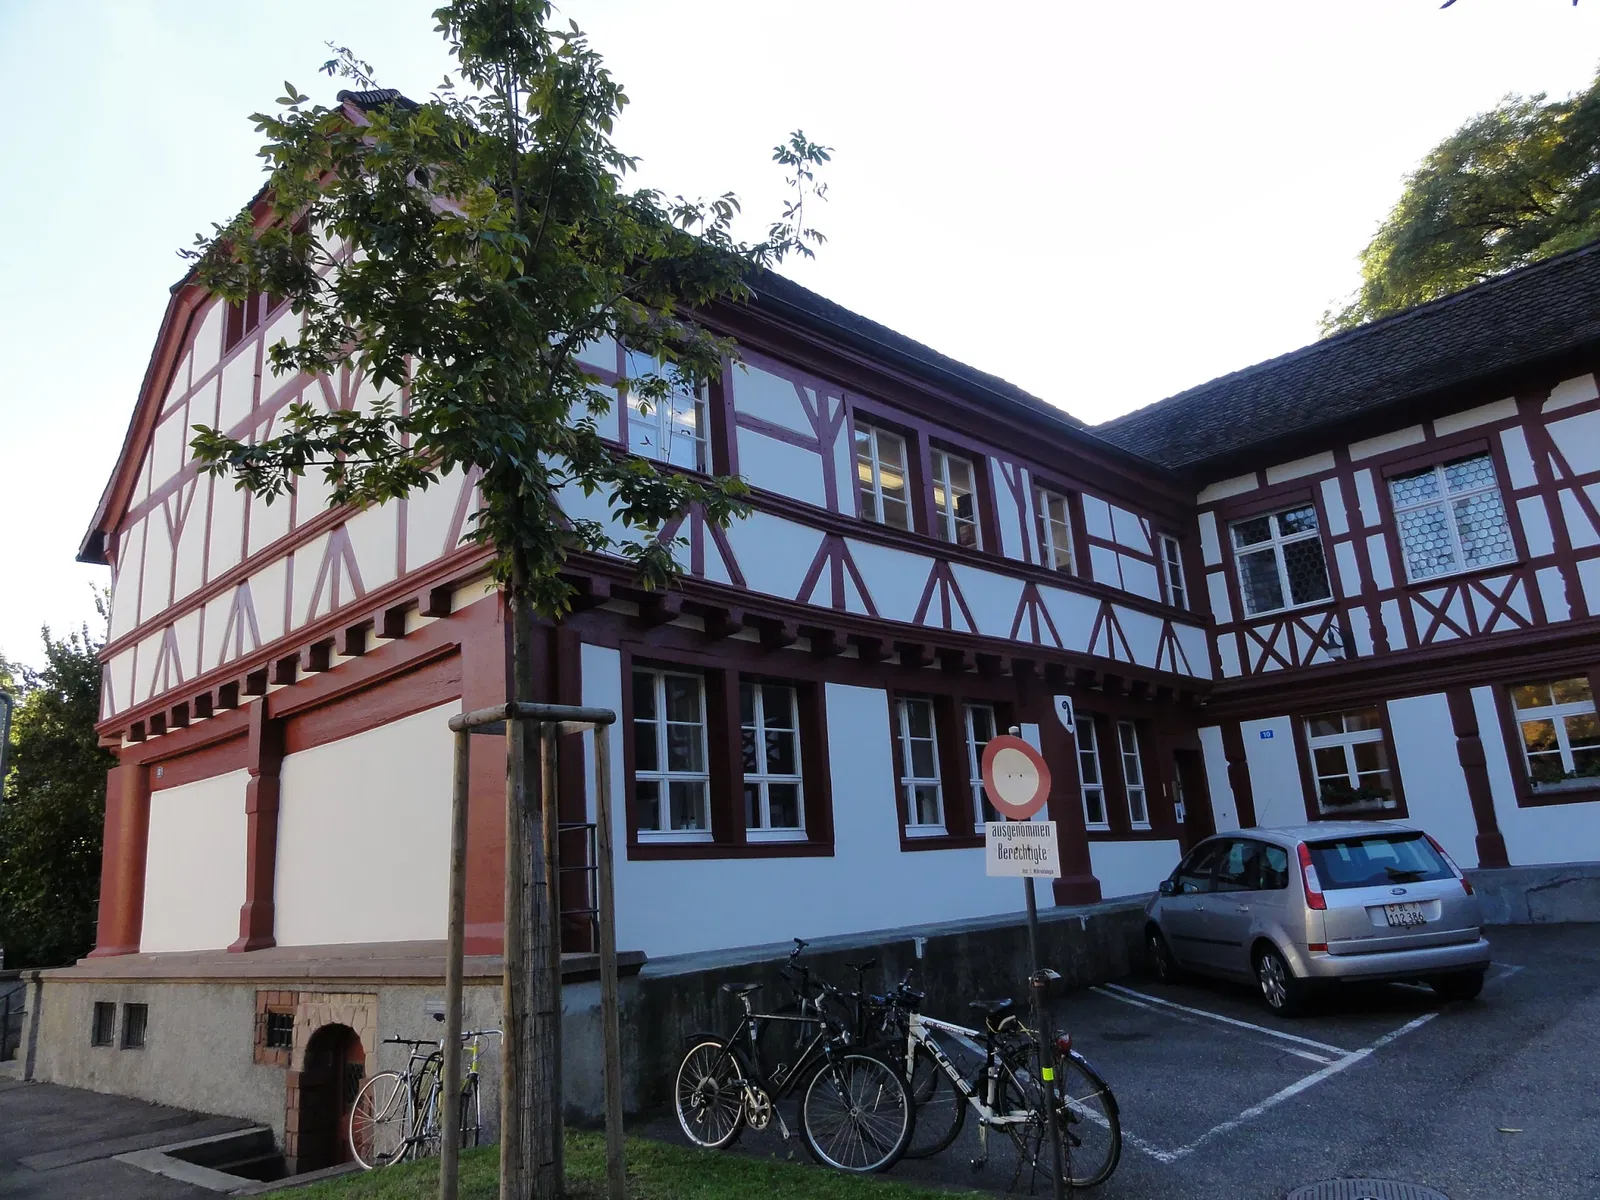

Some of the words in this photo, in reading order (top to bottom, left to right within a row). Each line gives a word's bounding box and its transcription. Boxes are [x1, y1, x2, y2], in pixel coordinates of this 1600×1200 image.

[991, 825, 1050, 841] ausgenommen
[998, 843, 1047, 864] Berechtigte
[925, 1040, 972, 1096] CUBE
